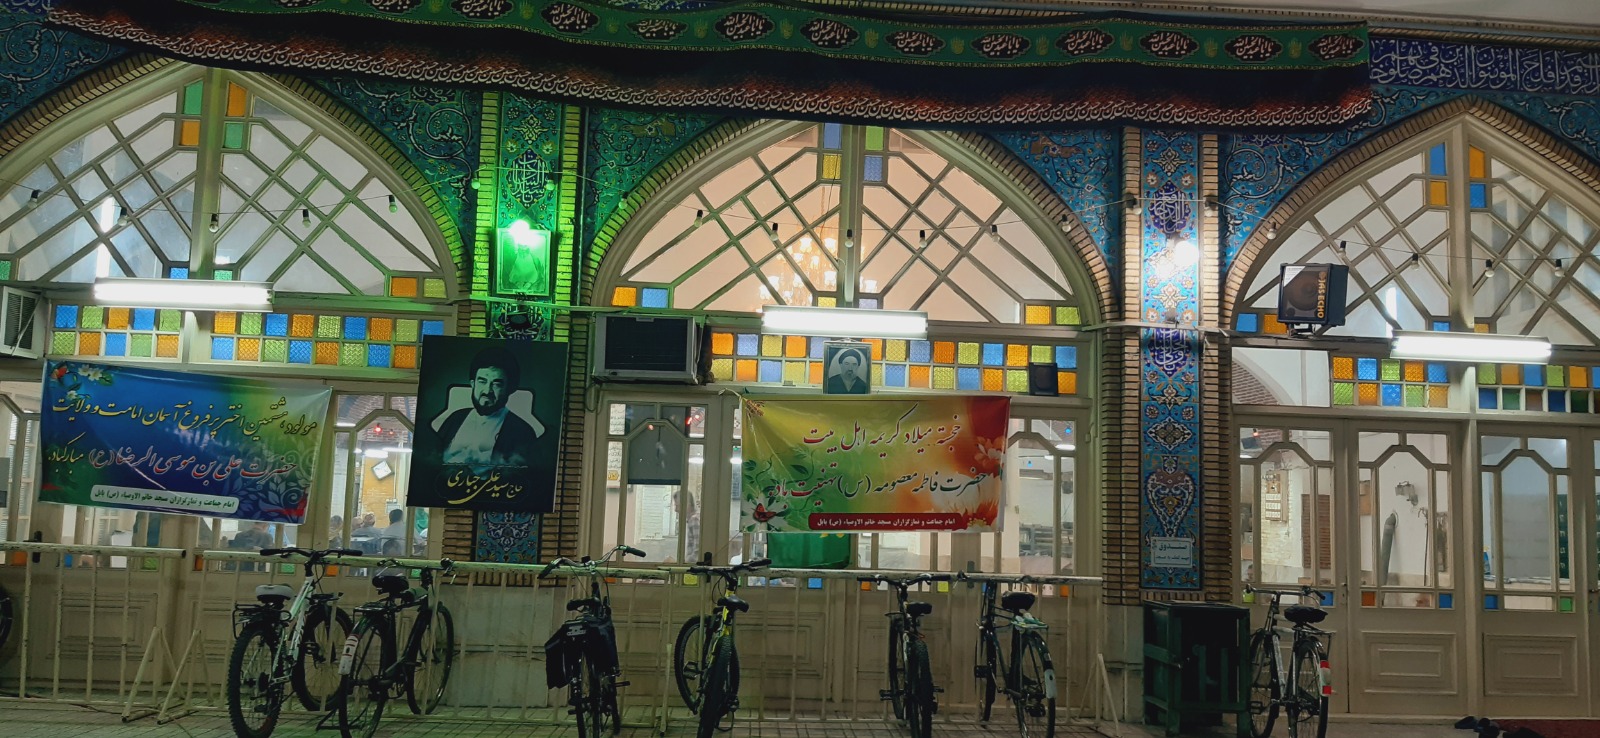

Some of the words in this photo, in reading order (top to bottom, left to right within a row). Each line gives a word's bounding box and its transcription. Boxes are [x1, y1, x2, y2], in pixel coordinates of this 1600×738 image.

[52, 398, 91, 421] ولایت
[97, 403, 142, 419] امامت
[284, 414, 316, 436] مولود
[840, 420, 866, 451] اهل
[869, 402, 919, 458] کریمه
[936, 414, 961, 452] خجسته
[803, 428, 838, 453] بیت
[904, 426, 933, 454] میلاد
[115, 445, 156, 467] الرضا
[152, 454, 196, 475] موسی
[192, 460, 216, 486] بن
[213, 455, 242, 481] علی
[240, 456, 297, 485] حضرت
[447, 470, 481, 493] جباری
[447, 471, 501, 505] علی
[485, 482, 509, 498] سید
[506, 484, 523, 499] حاج
[790, 462, 838, 506] تهنیت
[837, 474, 872, 498] (س)
[873, 472, 918, 492] معصومه
[911, 471, 939, 492] فاطمه
[939, 467, 987, 497] حضرت
[203, 498, 221, 507] جماعت
[816, 518, 828, 527] بابل
[864, 518, 876, 526] خاتم
[892, 518, 920, 527] نمازگزاران
[926, 518, 944, 526] جماعت
[944, 518, 956, 526] امام
